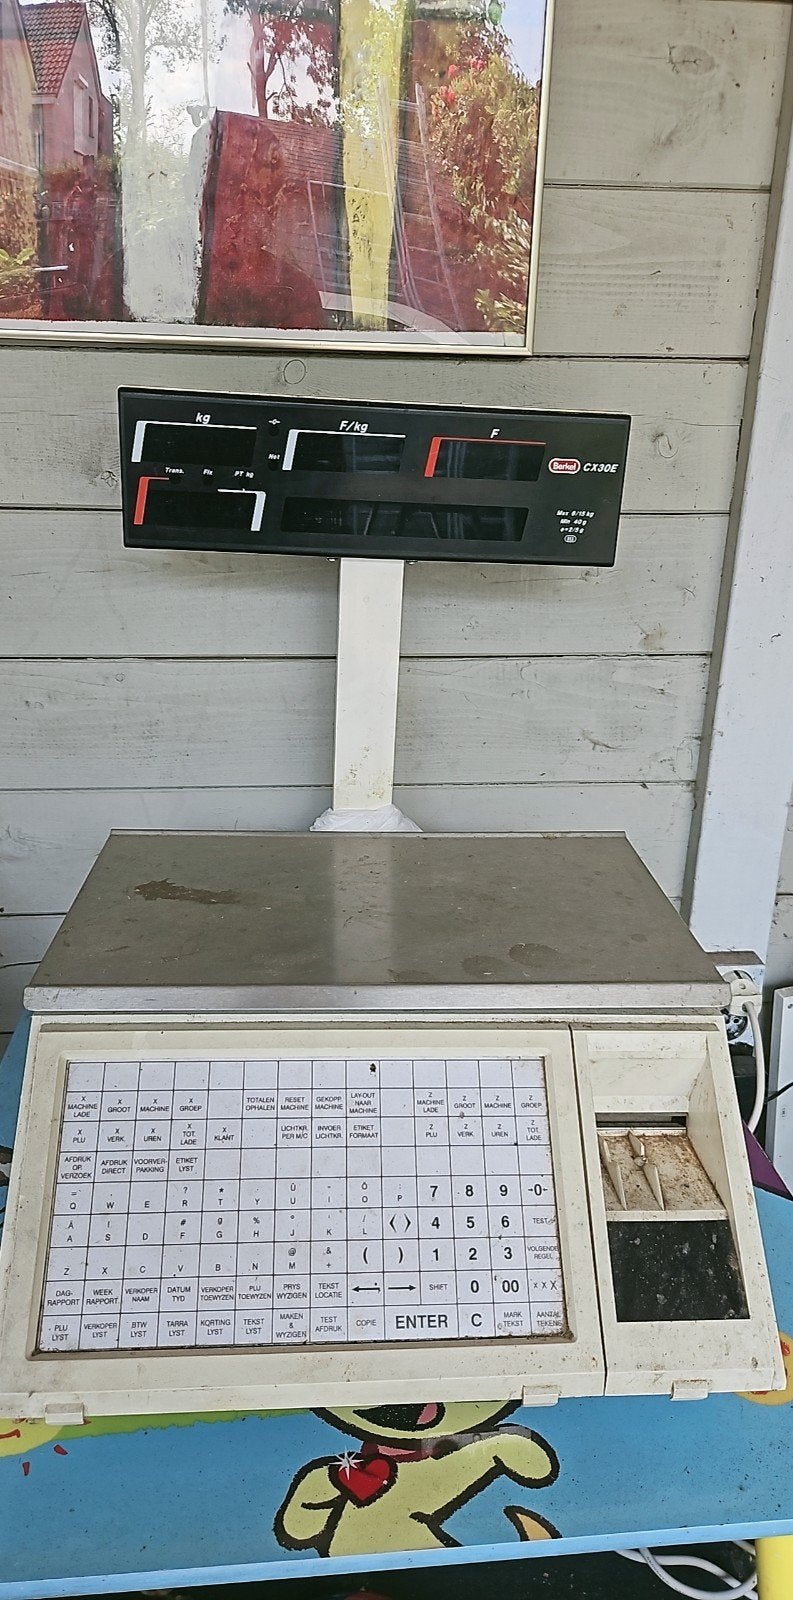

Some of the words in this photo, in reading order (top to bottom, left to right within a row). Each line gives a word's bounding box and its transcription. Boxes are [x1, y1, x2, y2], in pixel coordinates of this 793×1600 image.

[195, 412, 211, 424] kg
[339, 421, 369, 433] F/kg
[490, 429, 499, 439] F
[553, 462, 576, 470] Berkel
[583, 463, 618, 473] CX30E
[245, 471, 254, 479] kg
[430, 1185, 438, 1197] 7
[465, 1185, 474, 1197] 8
[500, 1185, 508, 1197] 9
[217, 1217, 223, 1225] g
[431, 1217, 440, 1229] 4
[466, 1216, 475, 1229] 5
[501, 1216, 510, 1228] 6
[433, 1249, 439, 1261] 1
[469, 1248, 477, 1260] 2
[504, 1247, 512, 1260] 3
[64, 1268, 69, 1276] Z
[283, 1283, 301, 1291] PRYS
[470, 1280, 479, 1293] 0
[502, 1280, 519, 1293] 00
[395, 1315, 448, 1329] ENTER
[471, 1313, 482, 1327] C
